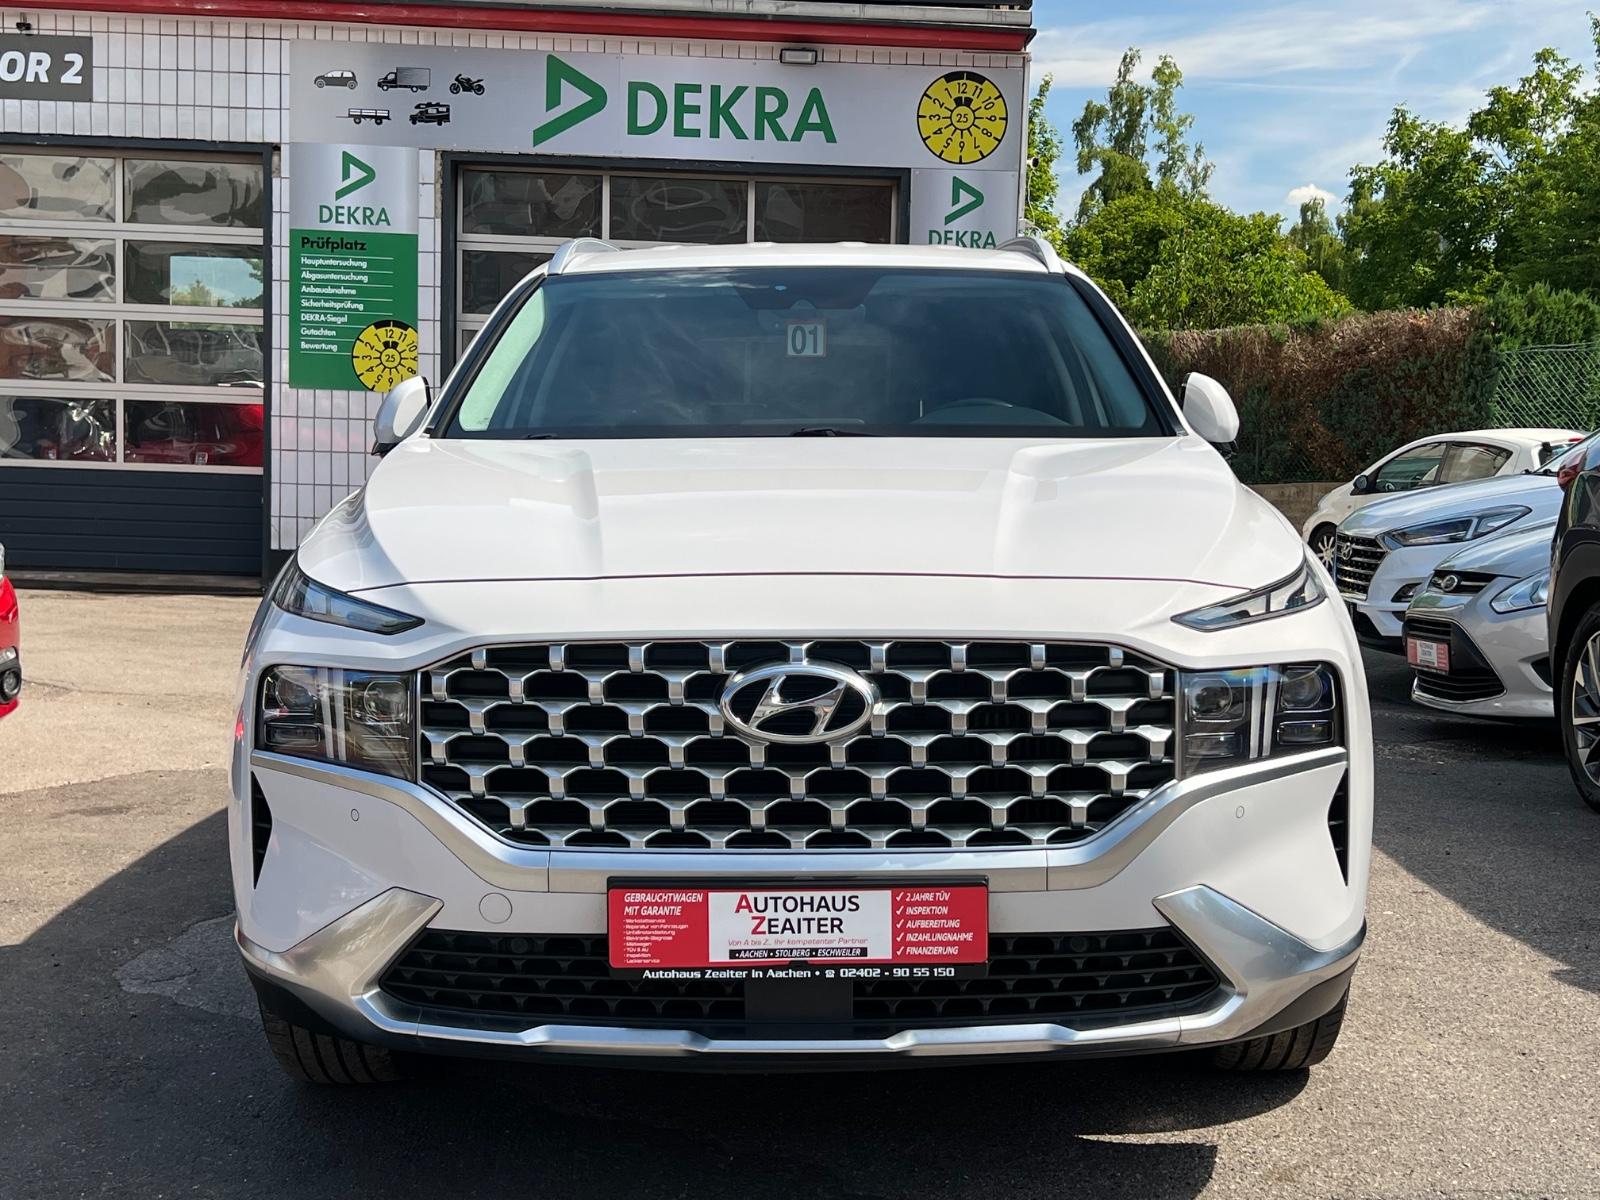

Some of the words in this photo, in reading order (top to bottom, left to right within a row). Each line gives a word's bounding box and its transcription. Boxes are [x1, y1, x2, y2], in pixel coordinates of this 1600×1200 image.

[60, 53, 83, 84] 2
[957, 82, 968, 94] 12
[972, 85, 983, 99] 11
[933, 97, 945, 108] 2
[982, 96, 995, 110] 10
[627, 81, 837, 144] DEKRA
[956, 113, 969, 123] 25
[981, 128, 993, 138] 8
[319, 205, 391, 226] DEKRA
[301, 237, 367, 253] Prüfplatz
[928, 230, 997, 249] DEKRA
[301, 257, 367, 269] Hauptuntersuchung
[301, 271, 368, 283] Abgasuntersuchung
[301, 285, 356, 295] Anbauabnahme
[301, 299, 364, 311] Sicherheitsprüfung
[301, 313, 348, 324] DEKRA-Siegel
[301, 327, 336, 336] Gutachten
[385, 329, 394, 339] 12
[397, 331, 408, 343] 11
[791, 325, 818, 354] 01
[301, 341, 338, 352] Bewertung
[406, 341, 418, 352] 10
[385, 354, 396, 363] 25
[406, 366, 417, 375] 8
[624, 892, 703, 903] GEBRAUCHTWAGEN
[906, 893, 911, 901] 2
[911, 892, 934, 901] JAHRE
[936, 890, 950, 901] TÜV
[735, 894, 860, 913] AUTOHAUS
[624, 906, 639, 916] MIT
[641, 906, 682, 916] GARANTIE
[906, 906, 948, 915] INSPEKTION
[751, 916, 844, 935] ZEAITER
[906, 919, 960, 928] AUFBEREITUNG
[787, 938, 836, 946] kompetenter
[906, 932, 973, 941] INZAHLUNGNAHME
[775, 949, 810, 957] STOLBERG
[817, 949, 861, 957] ESCHWEILER
[906, 946, 959, 955] FINANZIERUNG
[643, 969, 701, 979] Autohaus
[766, 968, 811, 978] Aachen
[840, 968, 881, 977] 02402
[893, 968, 909, 977] 90
[913, 968, 929, 977] 55
[933, 967, 955, 977] 150
